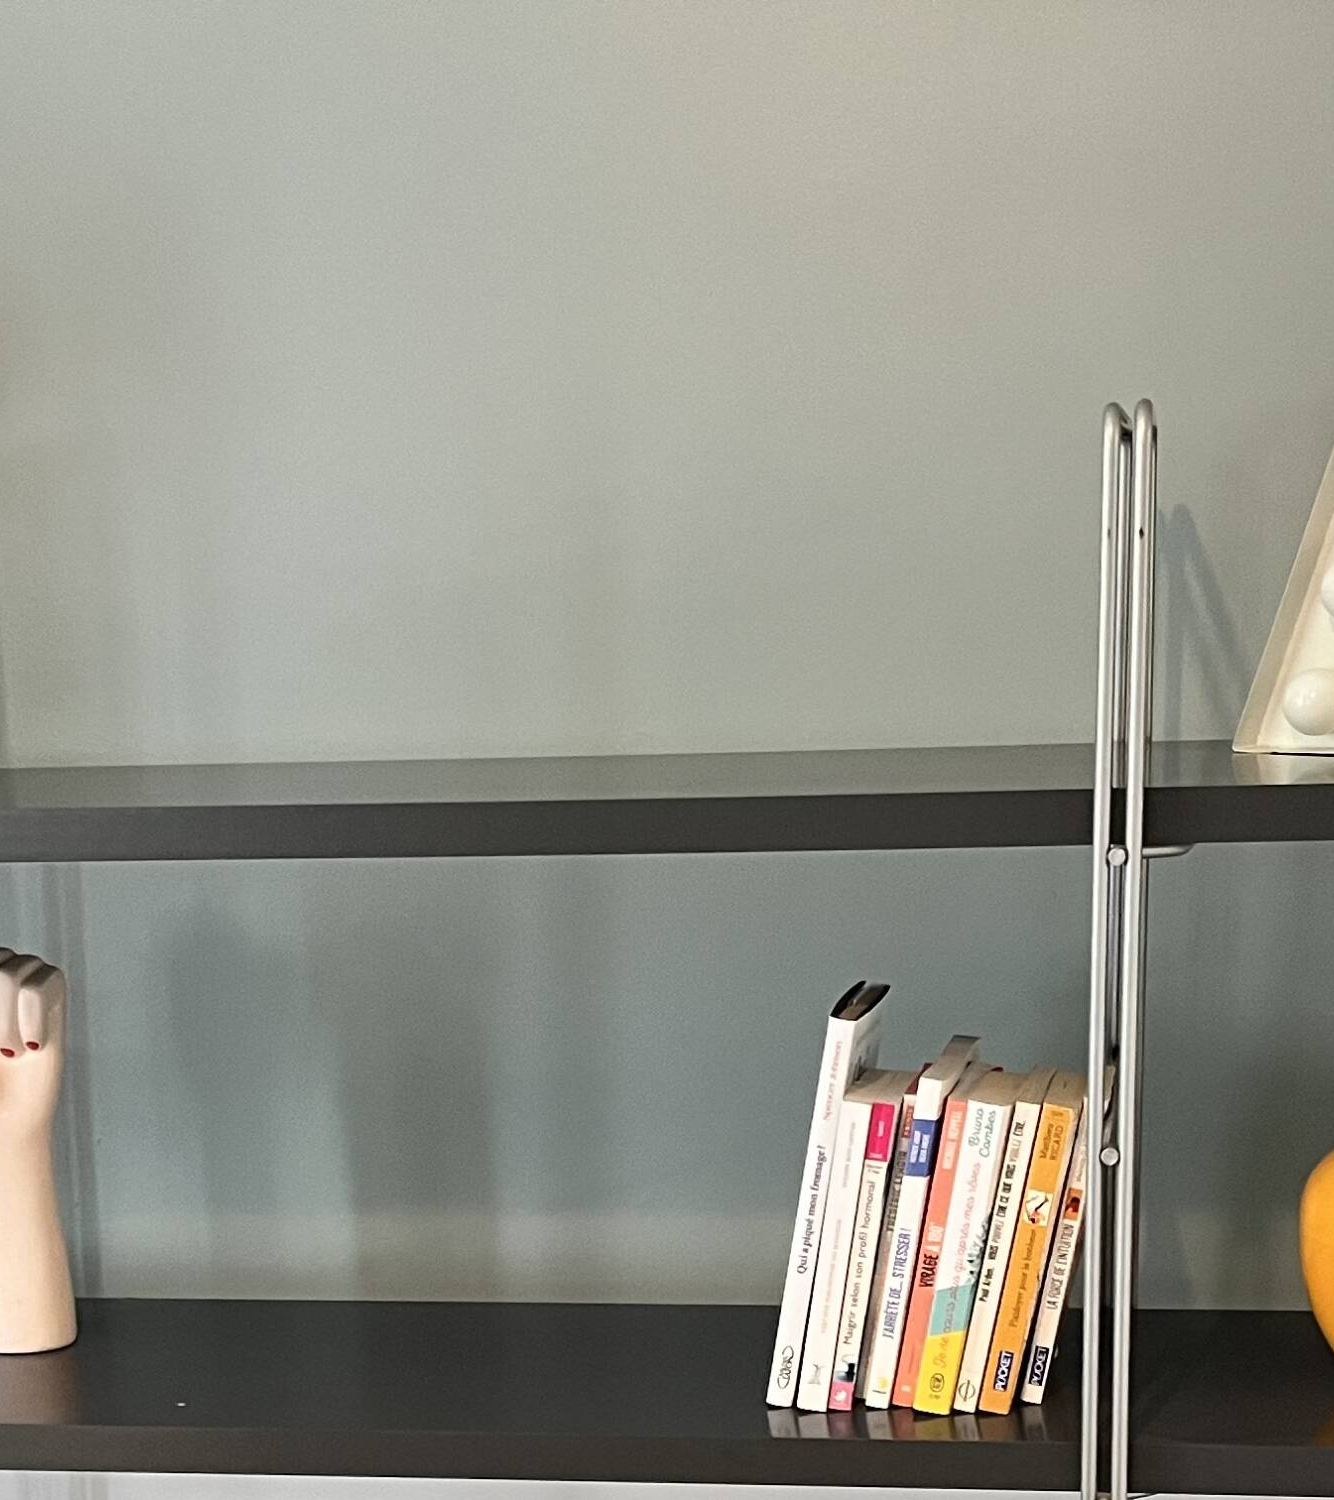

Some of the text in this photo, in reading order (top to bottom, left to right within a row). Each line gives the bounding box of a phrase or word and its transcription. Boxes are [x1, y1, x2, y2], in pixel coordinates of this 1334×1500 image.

[968, 1108, 984, 1147] Bruno
[979, 1111, 996, 1157] Combes
[1049, 1125, 1064, 1160] RICARD
[808, 1194, 818, 1216] mon
[803, 1218, 814, 1247] piqué
[797, 1255, 808, 1274] Qui
[843, 1181, 875, 1345] Maigrir selon son profil hormonal
[919, 1254, 939, 1287] VIRAGE
[1053, 1266, 1065, 1276] DE
[1048, 1277, 1063, 1298] FORCE
[883, 1301, 899, 1339] J'ARRÊTE
[1046, 1300, 1058, 1310] LA
[993, 1351, 1013, 1391] POCKET
[1029, 1346, 1049, 1385] POCKET
